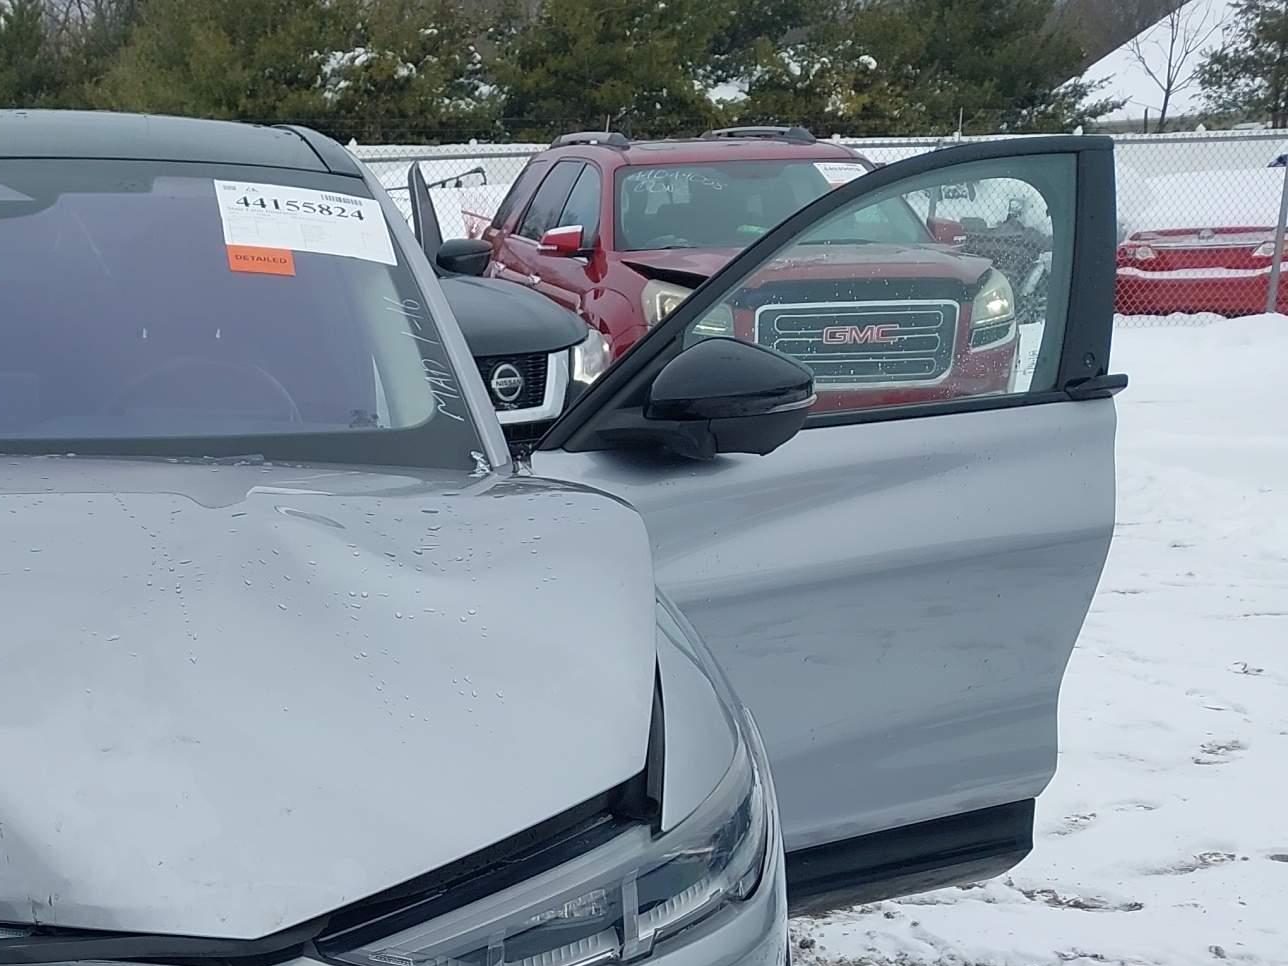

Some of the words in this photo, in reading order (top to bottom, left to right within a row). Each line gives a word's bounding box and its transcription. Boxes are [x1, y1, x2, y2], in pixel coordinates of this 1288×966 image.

[235, 195, 365, 221] 44155824
[234, 254, 288, 265] DETAILED
[822, 323, 900, 345] GMC
[495, 379, 521, 387] NISSAN
